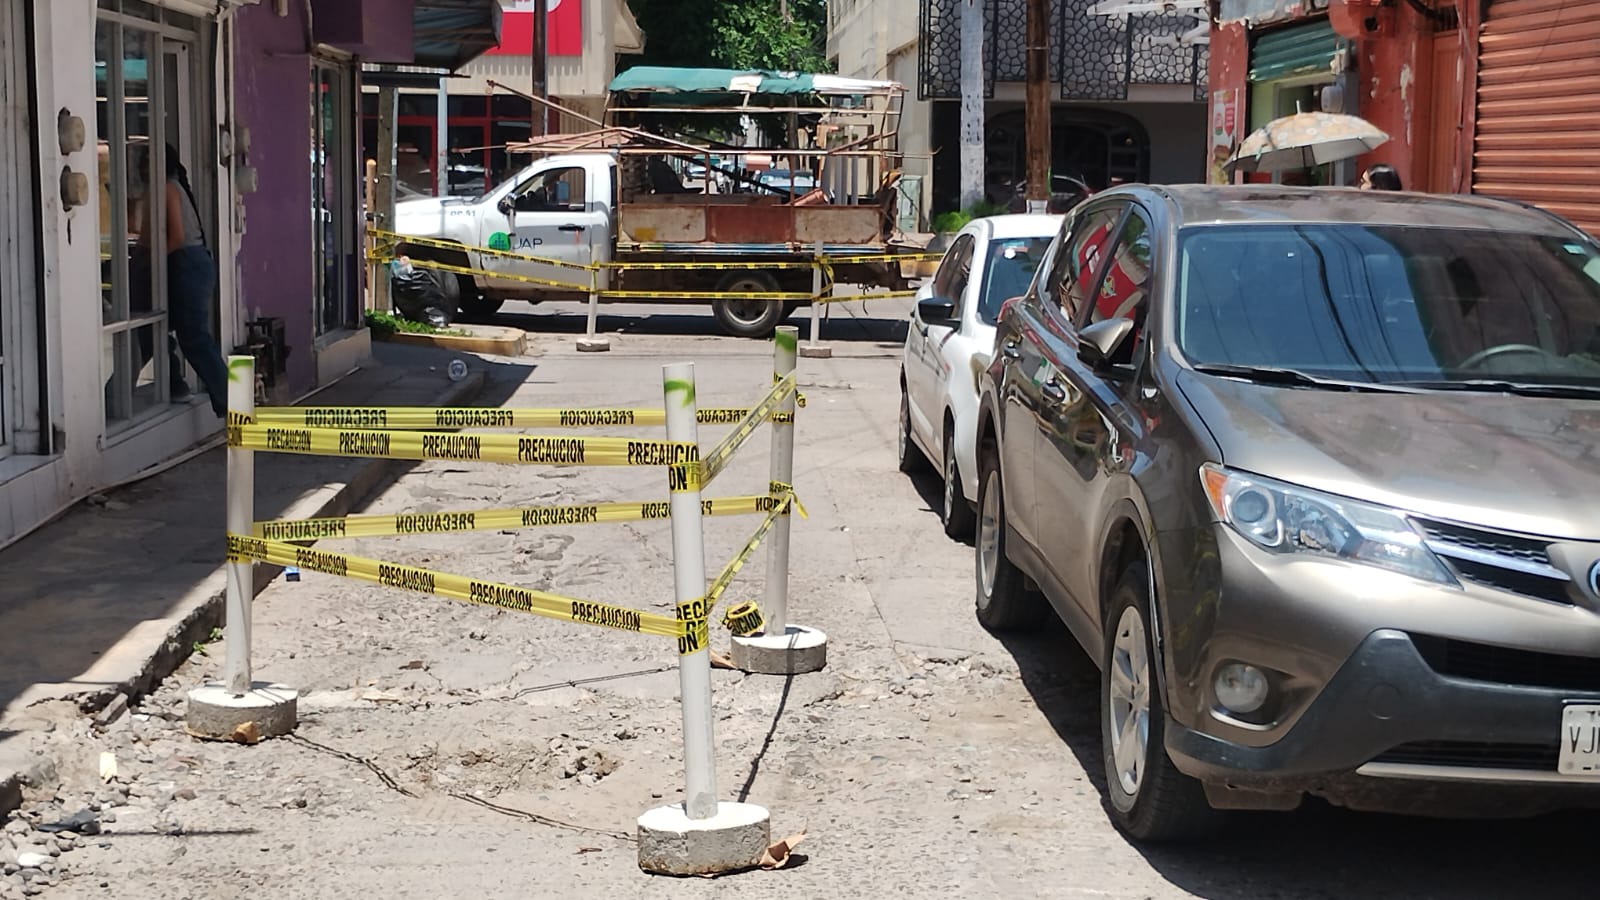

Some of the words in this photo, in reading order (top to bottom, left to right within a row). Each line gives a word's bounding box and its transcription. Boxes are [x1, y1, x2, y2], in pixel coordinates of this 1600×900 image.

[513, 238, 543, 250] JAP
[267, 428, 312, 451] PRECAUCION
[339, 432, 390, 456] PRECAUCION
[422, 435, 481, 460] PRECAUCION
[518, 438, 585, 463] PRECAUCION
[627, 441, 700, 466] PRECAUCIO
[296, 548, 347, 577] PRECAUCION
[378, 564, 435, 594] PRECAUCION
[469, 582, 533, 612] PRECAUCION
[571, 601, 641, 631] PRECAUCION
